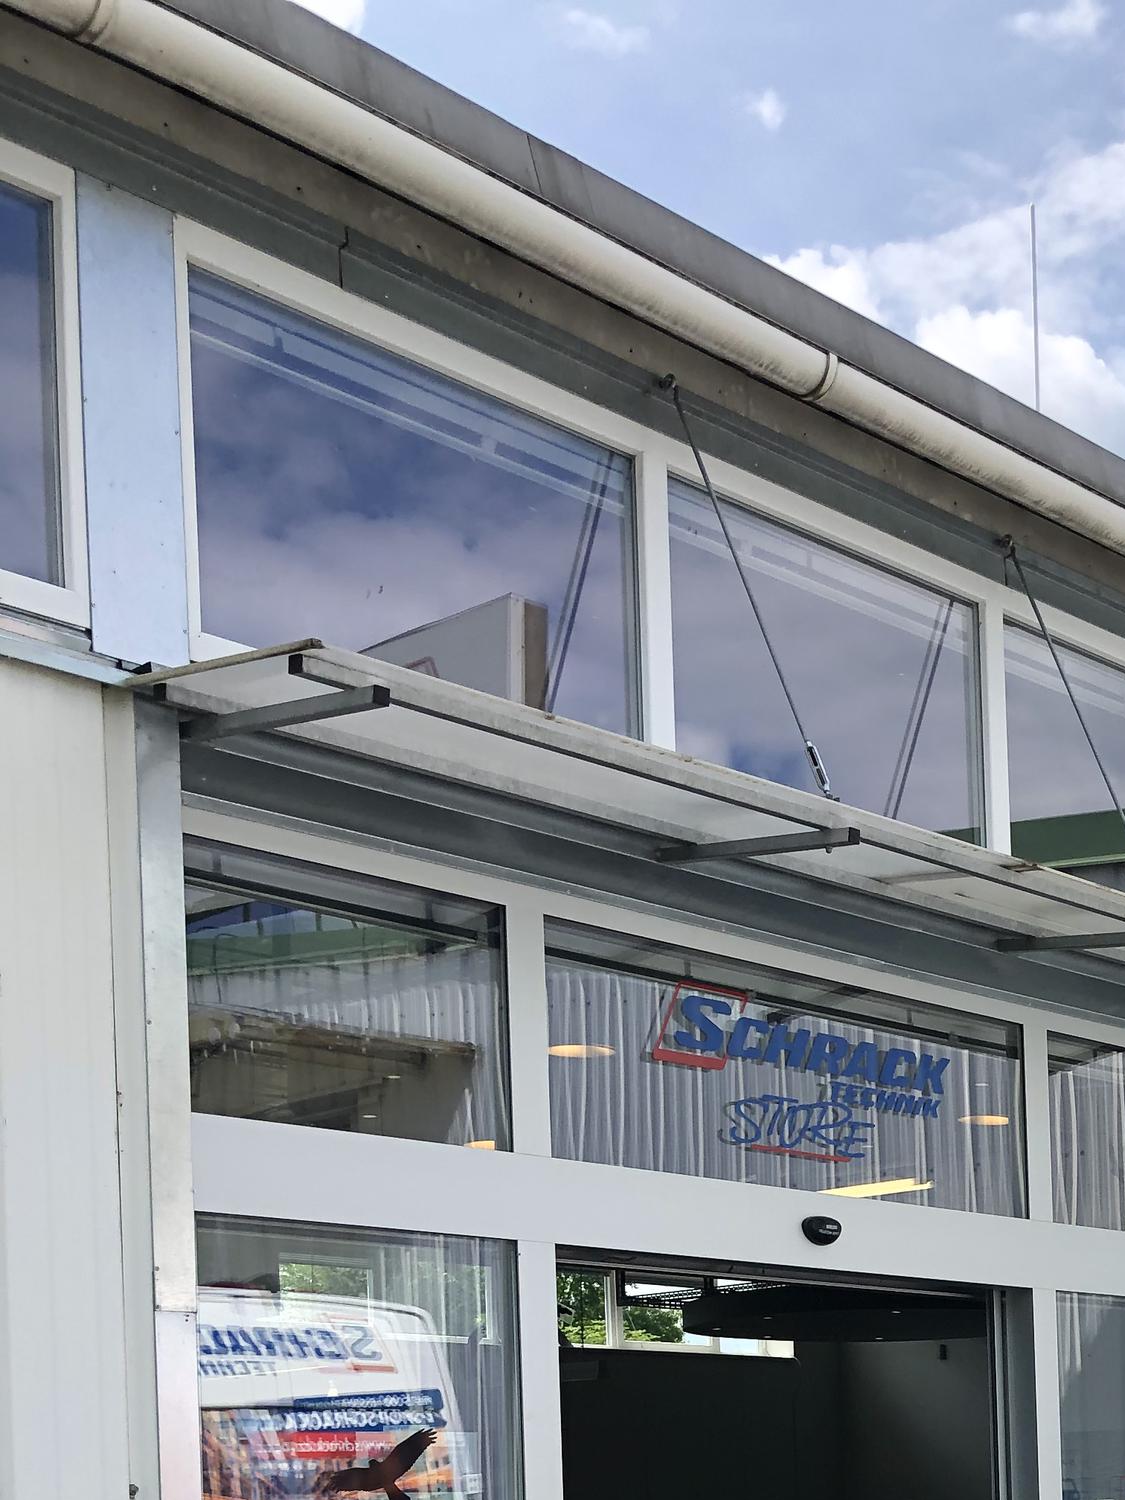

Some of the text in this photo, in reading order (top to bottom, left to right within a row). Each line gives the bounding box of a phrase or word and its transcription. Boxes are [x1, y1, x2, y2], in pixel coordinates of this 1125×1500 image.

[674, 996, 950, 1094] SCHRACK
[729, 1094, 875, 1158] STORE
[829, 1081, 942, 1118] TECHNIK
